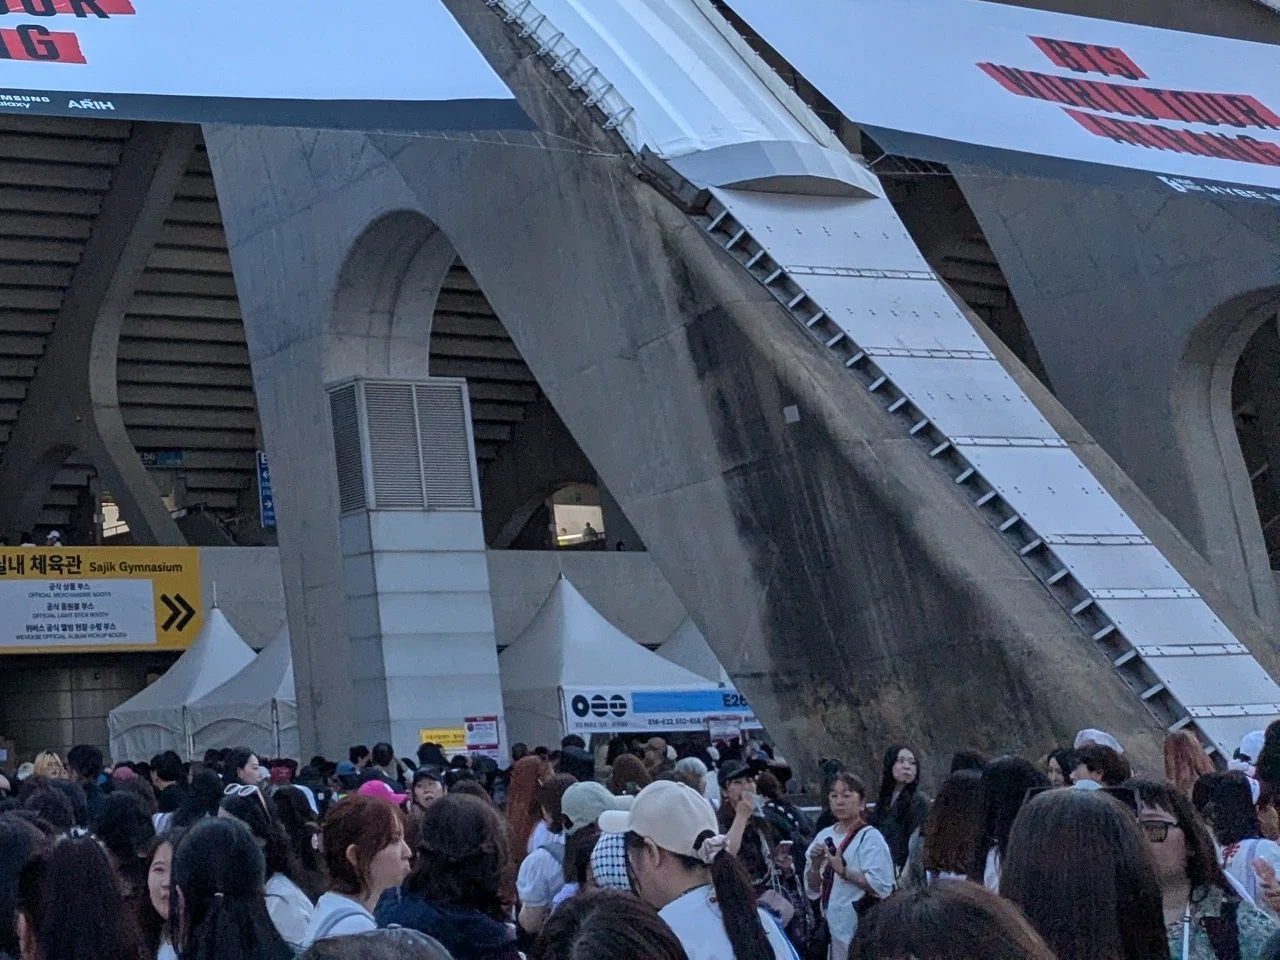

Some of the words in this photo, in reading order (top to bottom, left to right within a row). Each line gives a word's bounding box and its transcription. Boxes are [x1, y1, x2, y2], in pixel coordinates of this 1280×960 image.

[1039, 37, 1139, 80] BTS
[985, 61, 1159, 120] WORLD
[1143, 88, 1279, 130] TOUR
[30, 554, 82, 575] 체육관
[89, 562, 116, 575] Sajik
[119, 562, 183, 574] Gymnasium
[49, 582, 62, 591] 공식
[77, 582, 91, 590] 부스
[46, 602, 60, 611] 공식
[81, 602, 94, 610] 부스
